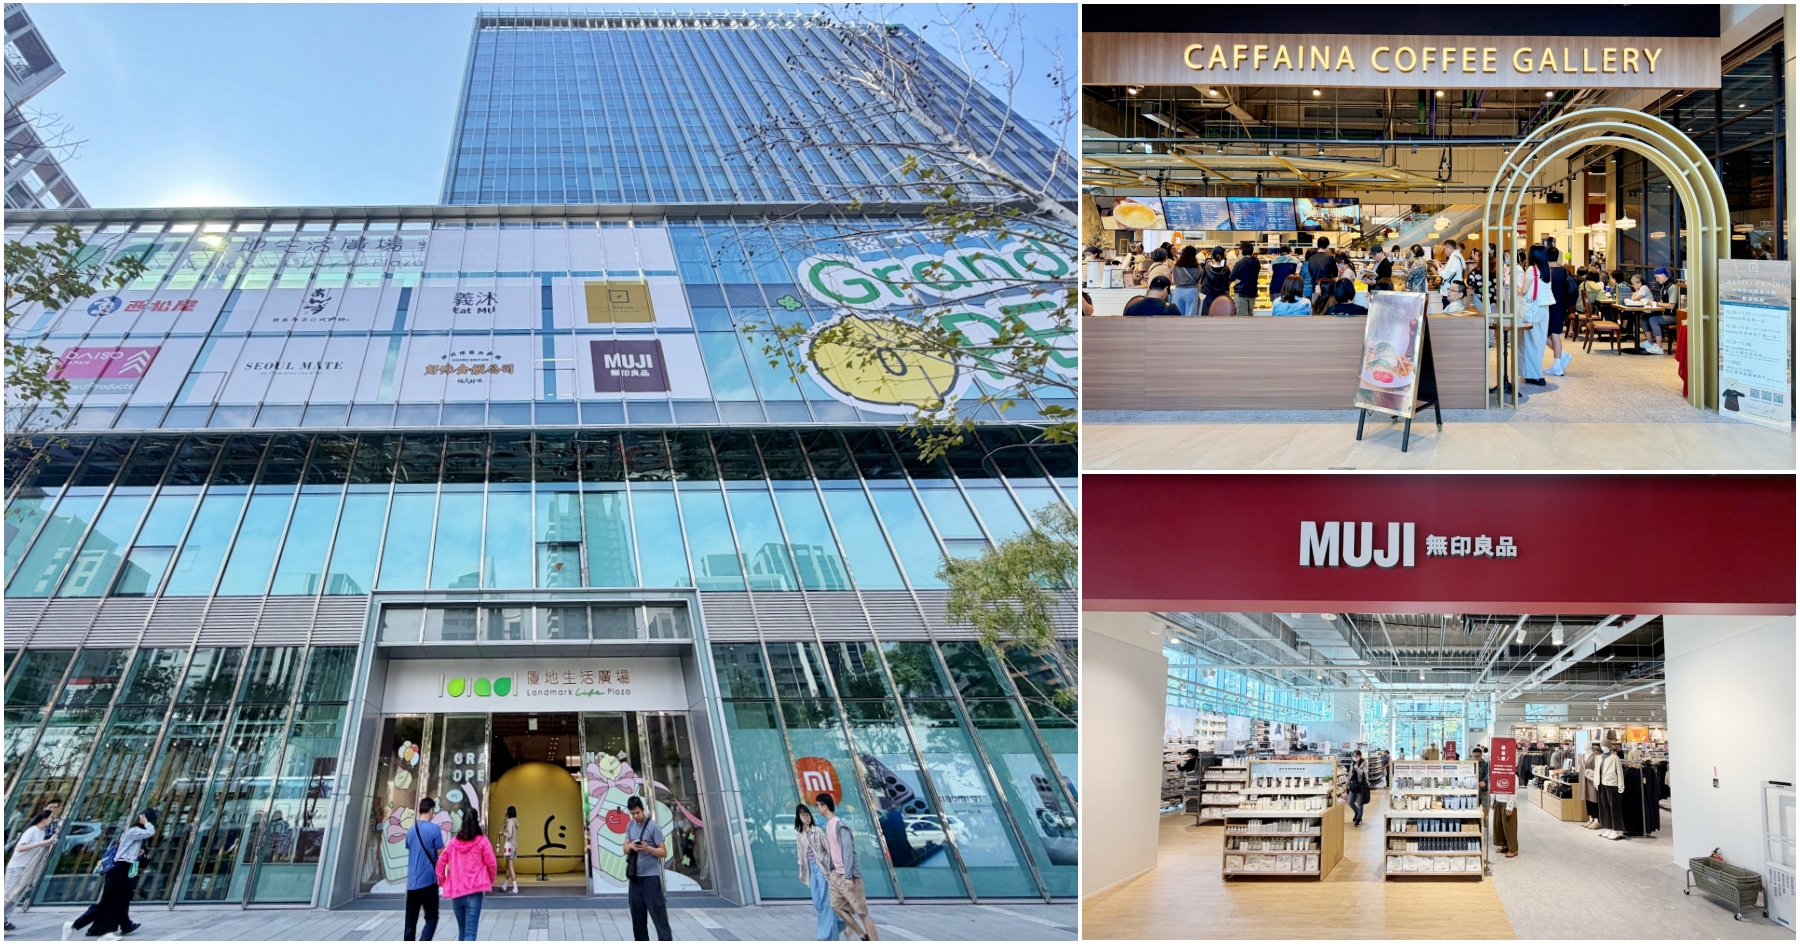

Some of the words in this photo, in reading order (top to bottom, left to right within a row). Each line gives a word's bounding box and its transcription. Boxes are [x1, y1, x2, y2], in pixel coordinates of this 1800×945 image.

[1183, 43, 1356, 71] CAFFAINA
[1371, 46, 1498, 73] COFFEE
[1513, 47, 1663, 73] GALLERY
[808, 237, 1070, 304] Grand
[1750, 280, 1787, 288] OPENING
[453, 291, 498, 306] 義沐
[453, 306, 472, 314] Eat
[65, 351, 124, 360] DAISO
[603, 353, 654, 369] MUJI
[244, 361, 294, 370] SEOUL
[300, 361, 344, 370] MATE
[610, 369, 650, 377] 無印良品
[1299, 521, 1415, 569] MUJI
[1426, 534, 1518, 558] 無印良品
[527, 670, 631, 685] 置地生活廣場
[527, 687, 573, 696] Landmark
[608, 688, 631, 696] Plaza
